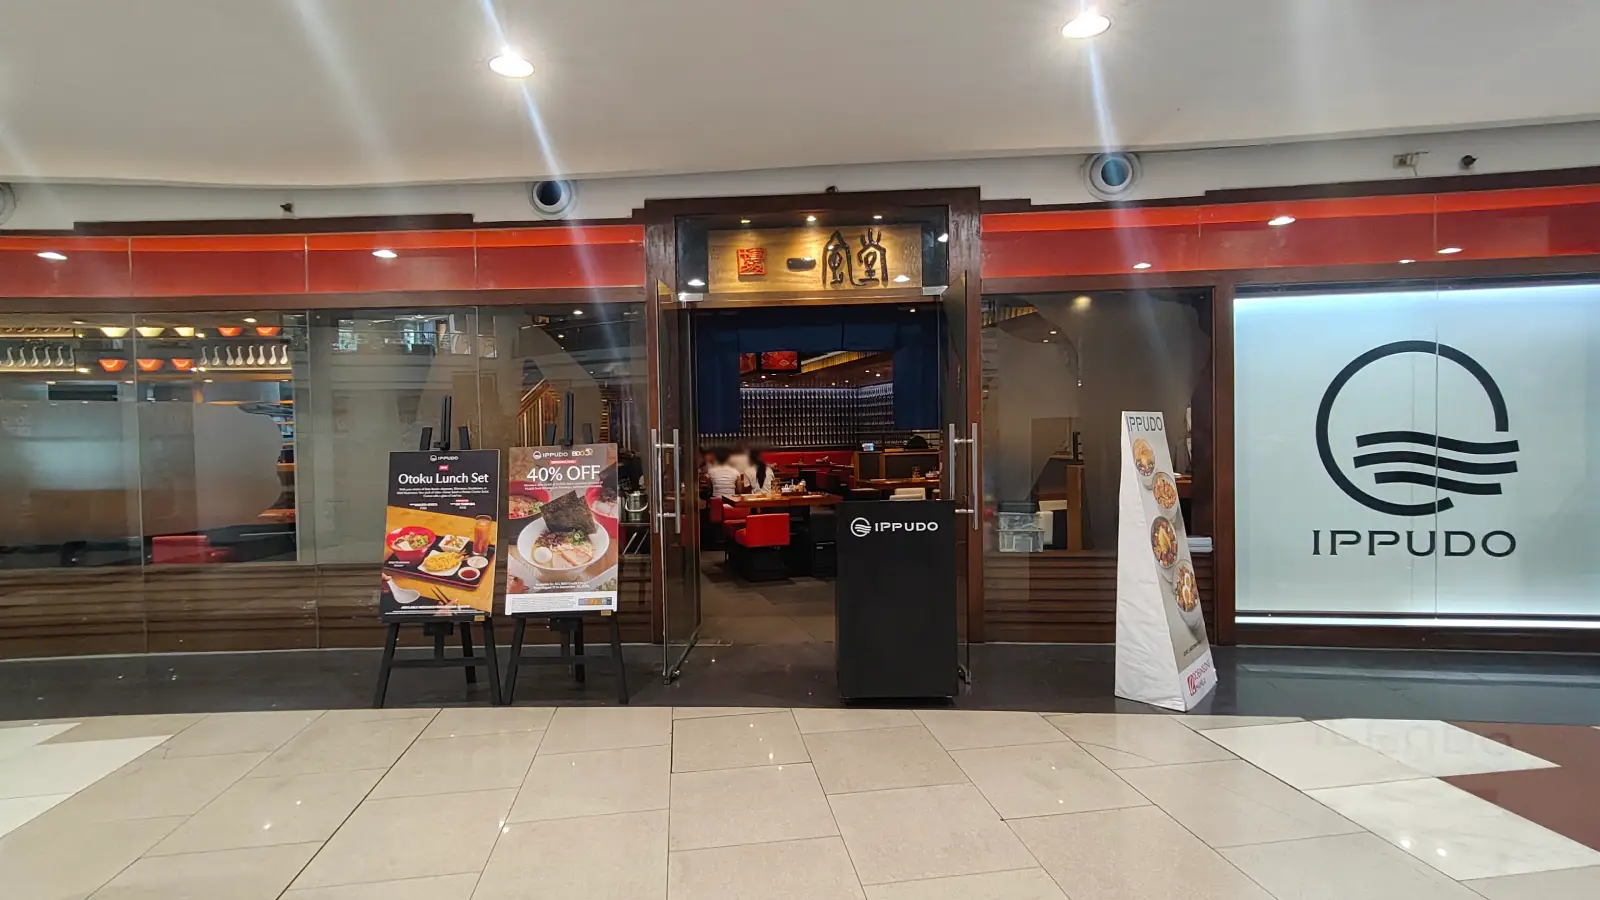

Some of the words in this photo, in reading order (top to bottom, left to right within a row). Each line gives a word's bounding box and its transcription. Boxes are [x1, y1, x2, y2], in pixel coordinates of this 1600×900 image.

[785, 227, 889, 289] 一風堂
[1125, 415, 1163, 432] IPPUDO
[398, 473, 433, 484] Otoku
[435, 472, 469, 484] Lunch
[471, 472, 489, 483] Set
[526, 466, 563, 482] 40%
[566, 465, 601, 481] OFF
[875, 521, 939, 532] IPPUDO
[1312, 530, 1517, 557] IPPUDO
